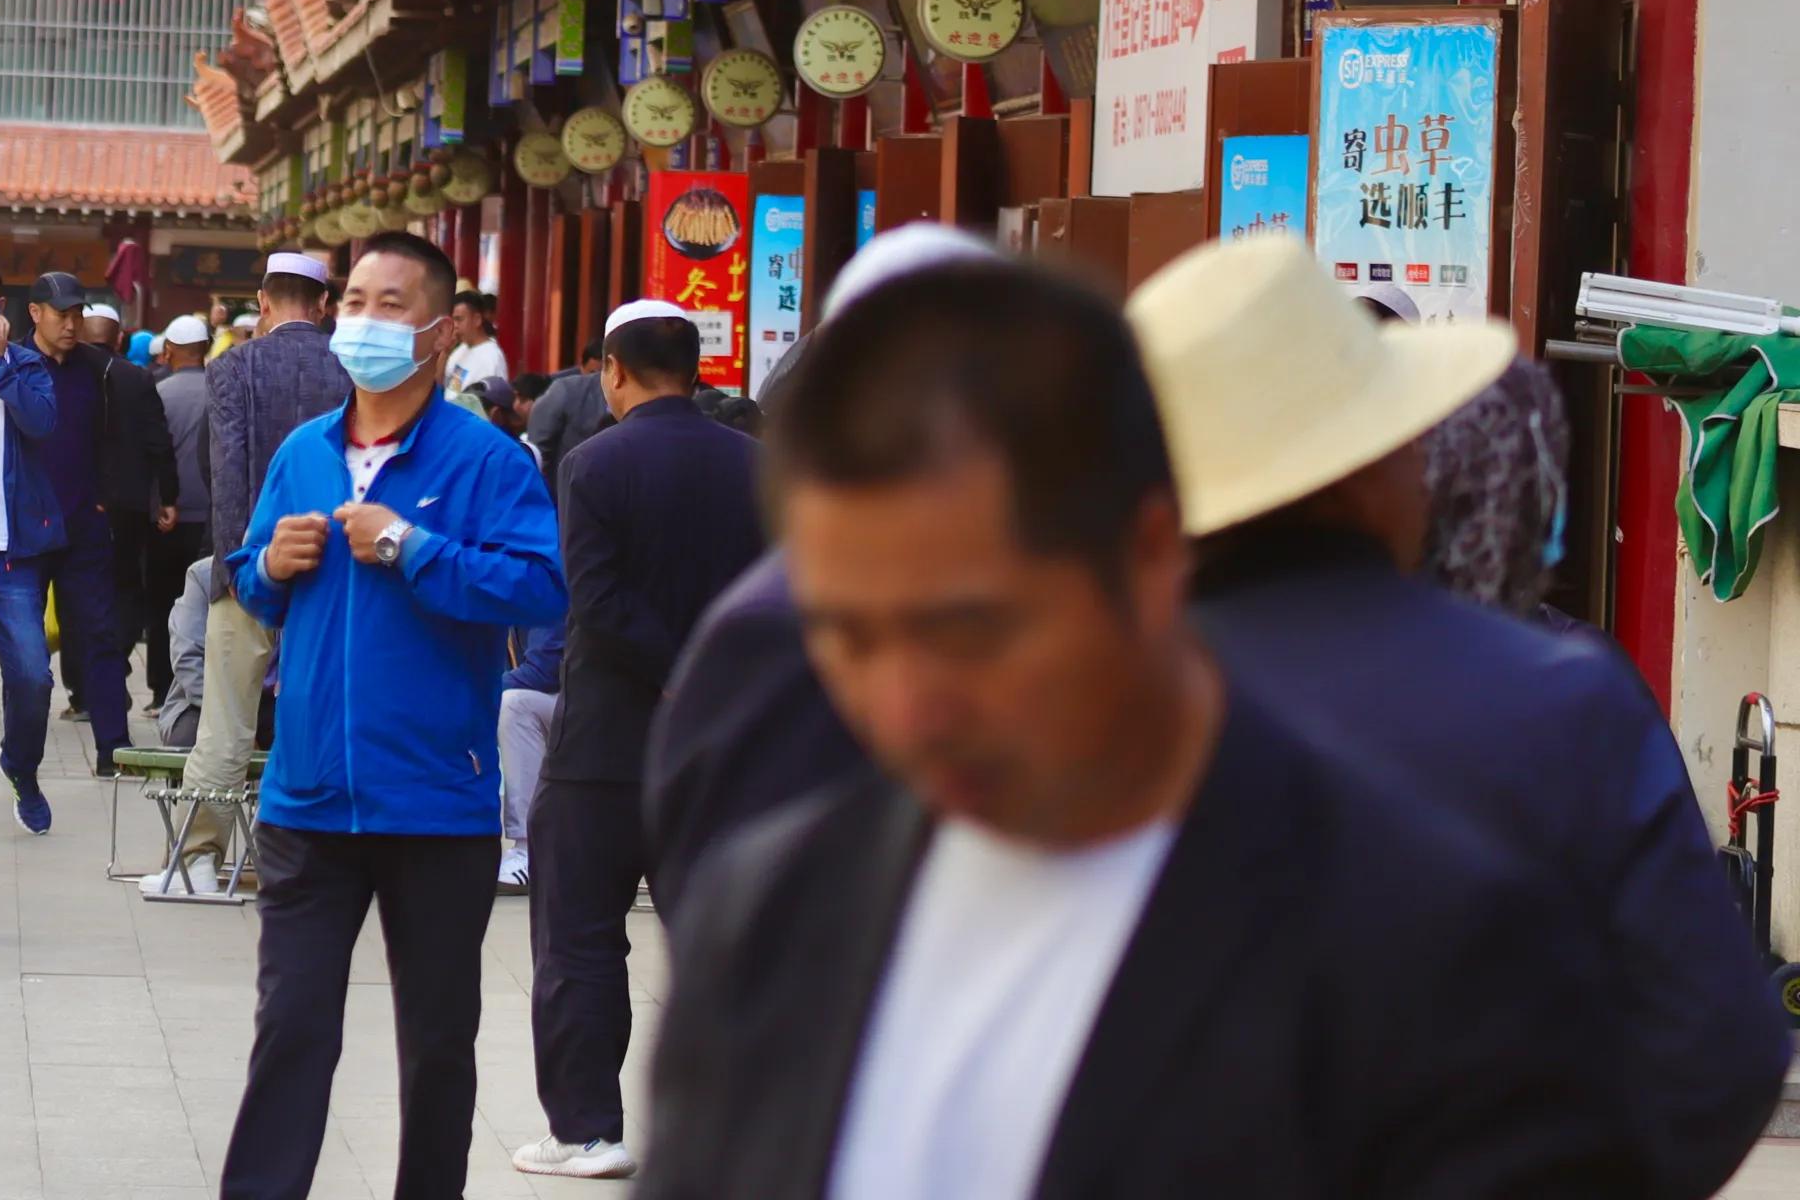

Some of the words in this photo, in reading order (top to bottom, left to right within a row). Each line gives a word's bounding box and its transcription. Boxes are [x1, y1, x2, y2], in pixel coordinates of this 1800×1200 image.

[1341, 112, 1456, 176] 寄虫草
[1358, 181, 1467, 231] 选顺丰
